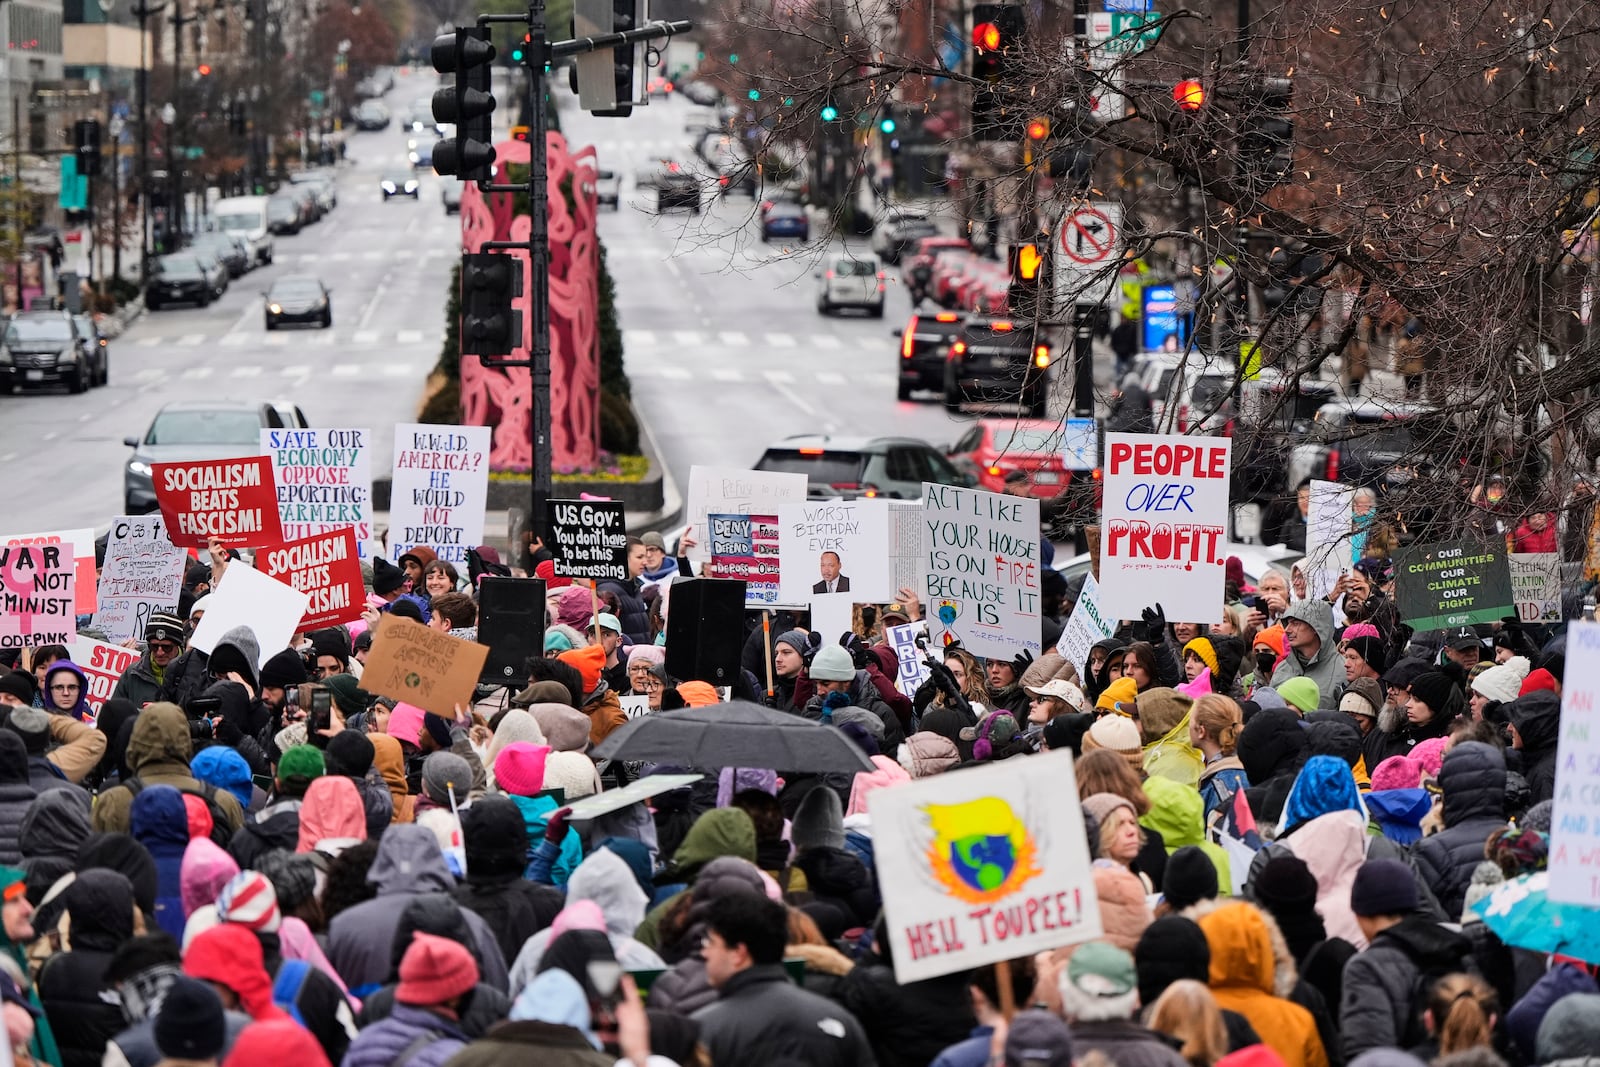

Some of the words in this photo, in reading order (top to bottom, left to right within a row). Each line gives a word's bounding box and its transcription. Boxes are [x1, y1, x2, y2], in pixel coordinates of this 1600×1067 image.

[270, 431, 318, 448] SAVE
[328, 430, 364, 448] OUR
[413, 432, 468, 452] W.W.J.D.
[276, 448, 358, 466] ECONOMY
[398, 451, 482, 472] AMERICA?
[1110, 443, 1227, 478] PEOPLE
[164, 462, 260, 492] SOCIALISM
[282, 466, 350, 484] OPPOSE
[430, 471, 450, 489] HE
[190, 489, 239, 512] BEATS
[276, 485, 366, 503] EPORTING:
[412, 488, 464, 508] WOULD
[926, 485, 964, 511] ACT
[974, 494, 1022, 522] LIKE
[1126, 484, 1195, 512] OVER
[178, 508, 262, 535] FASCISM!
[424, 507, 452, 525] NOT
[554, 504, 581, 526] U.S.
[580, 505, 620, 527] Gov:
[404, 525, 464, 544] DEPORT
[552, 526, 575, 546] You
[576, 528, 602, 546] don't
[602, 528, 627, 548] have
[713, 518, 751, 538] DENY
[714, 541, 748, 554] DEFEND
[927, 520, 982, 549] YOUR
[988, 529, 1037, 560] HOUSE
[1108, 519, 1224, 566] PROFIT.
[268, 535, 347, 576] SOCIALISM
[562, 545, 574, 560] to
[575, 546, 590, 560] be
[590, 546, 614, 561] this
[1408, 554, 1495, 573] COMMUNITIES
[1438, 548, 1462, 558] OUR
[290, 564, 330, 591] BEATS
[553, 558, 626, 580] Embarrassing
[930, 551, 950, 570] IS
[956, 554, 986, 576] ON
[994, 555, 1038, 589] FIRE
[1440, 568, 1465, 578] OUR
[34, 573, 72, 592] NOT
[1427, 576, 1480, 590] CLIMATE
[305, 582, 350, 615] CISM!
[927, 574, 1006, 604] BECAUSE
[1018, 588, 1038, 614] IT
[1438, 597, 1475, 610] FIGHT
[1443, 588, 1468, 599] OUR
[1511, 588, 1544, 600] ORATE
[100, 601, 130, 612] LGBTQ
[976, 603, 1000, 624] IS
[384, 624, 460, 658] CLIMATE
[392, 644, 453, 676] ACTION
[1568, 690, 1593, 712] AN
[904, 917, 965, 961] HELL
[968, 888, 1082, 945] TOUPEE!
